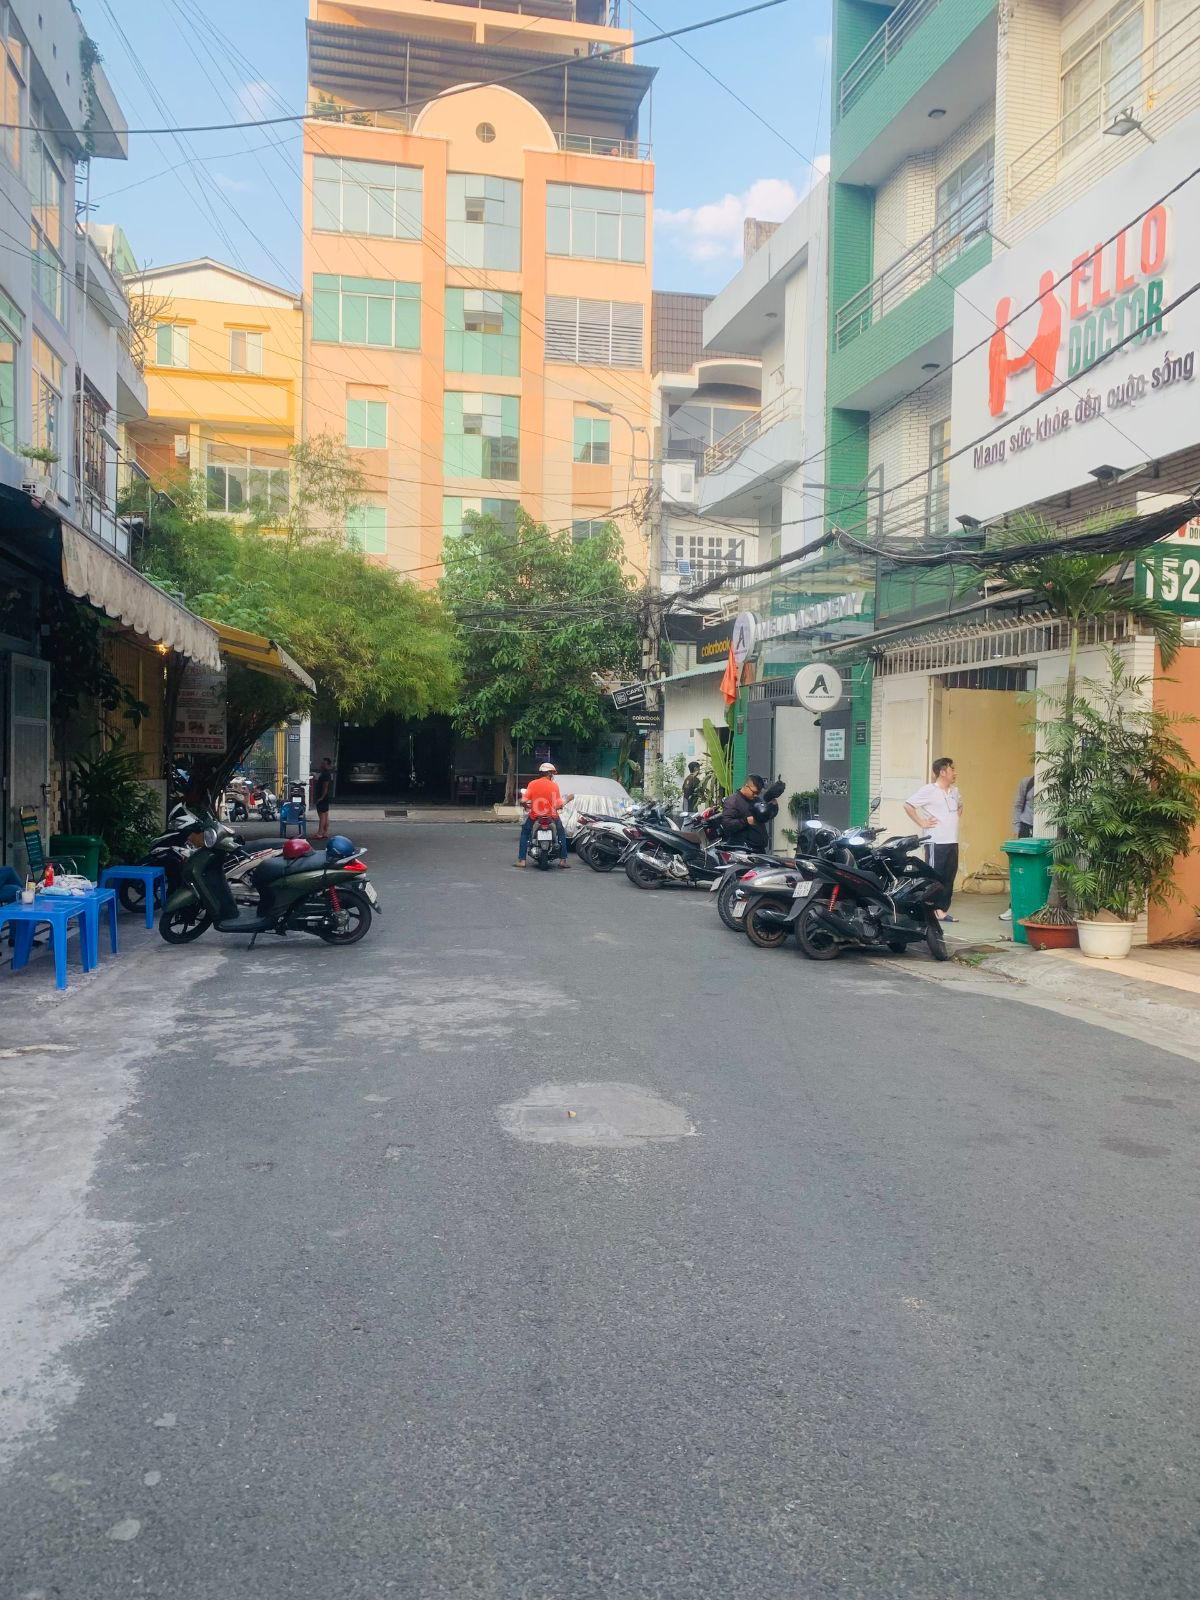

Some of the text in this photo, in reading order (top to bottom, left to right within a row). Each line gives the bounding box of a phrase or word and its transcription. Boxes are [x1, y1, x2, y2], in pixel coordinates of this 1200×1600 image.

[988, 204, 1168, 417] HELLO
[1067, 278, 1165, 379] DOCTOR
[973, 439, 1006, 469] Mang
[1009, 425, 1032, 453] sức
[1036, 406, 1071, 441] khỏe
[1151, 350, 1195, 389] sống
[797, 592, 865, 631] ACADEMY
